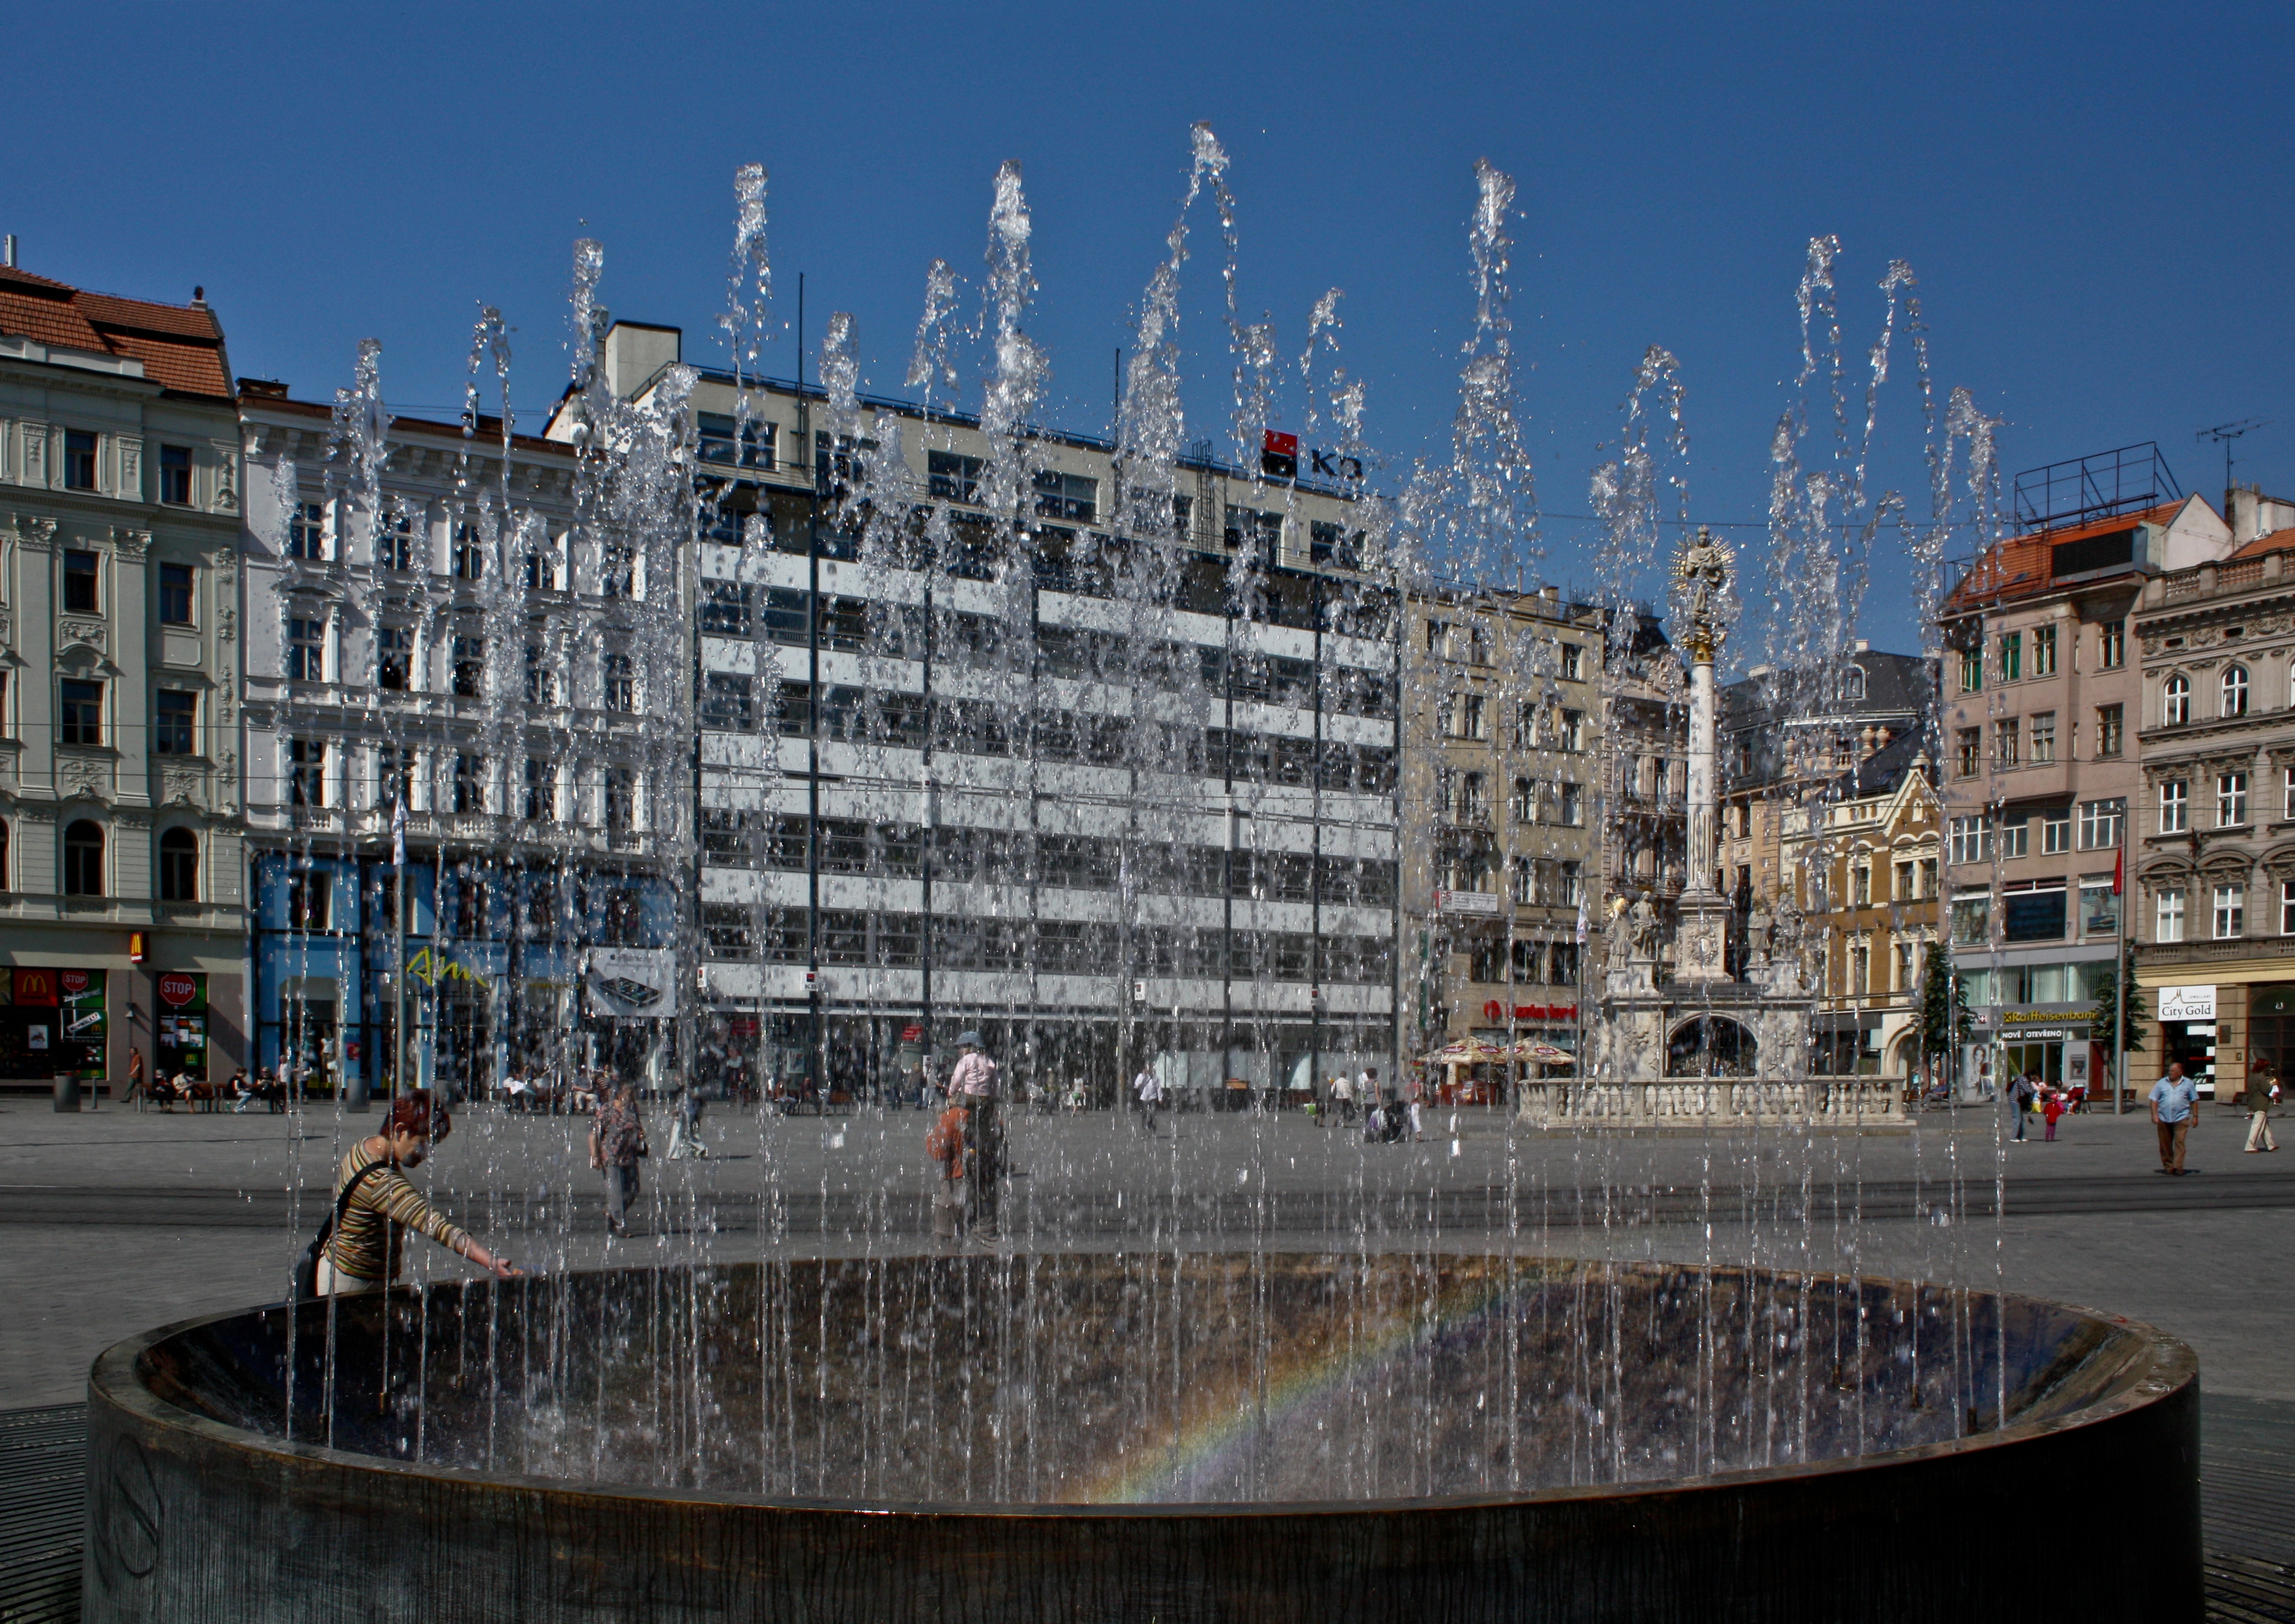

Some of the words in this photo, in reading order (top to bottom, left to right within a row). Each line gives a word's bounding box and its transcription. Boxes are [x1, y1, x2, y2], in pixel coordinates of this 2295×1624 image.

[65, 975, 86, 984] STOP
[164, 982, 192, 994] STOP
[2162, 1006, 2183, 1019] City
[2186, 1004, 2211, 1015] Gold
[2026, 1029, 2062, 1038] OTEVŘENO
